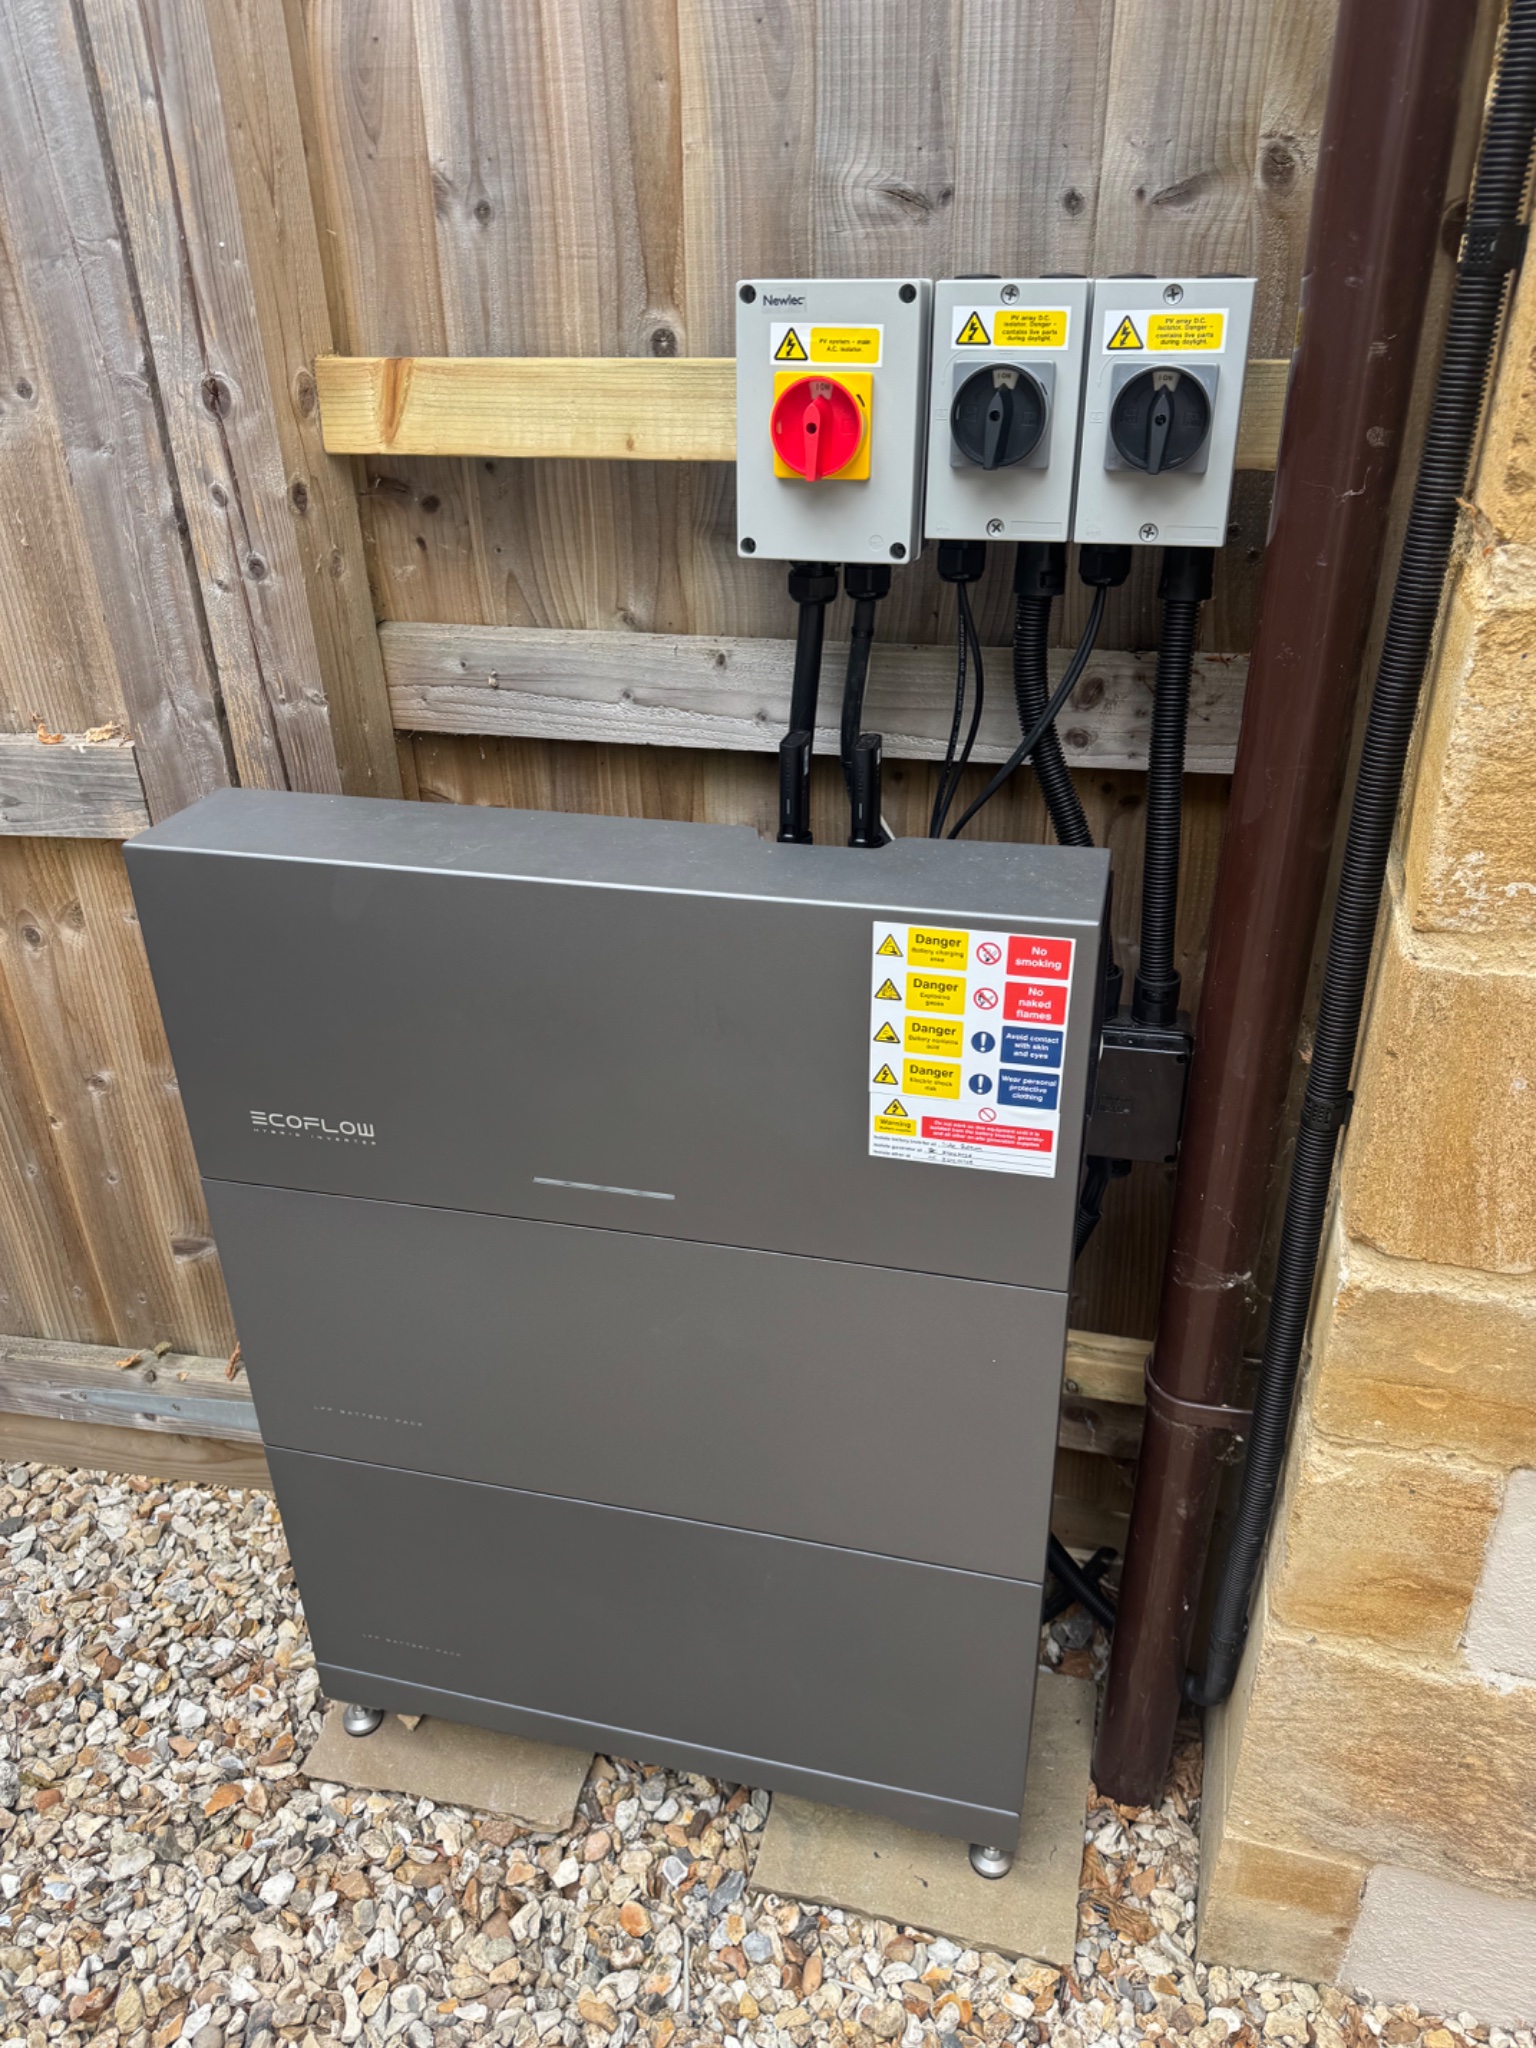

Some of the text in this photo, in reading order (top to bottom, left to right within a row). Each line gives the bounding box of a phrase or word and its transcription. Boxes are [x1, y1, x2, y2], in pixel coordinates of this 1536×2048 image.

[763, 294, 805, 306] Newlec
[915, 934, 962, 948] Danger
[912, 946, 964, 958] Battery charging
[1031, 946, 1048, 956] No
[1015, 958, 1062, 971] smoking
[913, 978, 958, 993] Danger
[1028, 987, 1044, 997] No
[1018, 998, 1051, 1009] naked
[1016, 1009, 1052, 1021] flames
[912, 1022, 956, 1036] Danger
[908, 1034, 930, 1043] Battery
[1006, 1032, 1059, 1044] Avoid contact
[910, 1064, 954, 1078] Danger
[910, 1076, 952, 1087] Electric shock
[1002, 1075, 1057, 1087] Wear personal
[1008, 1085, 1048, 1094] protective
[1012, 1092, 1043, 1102] clothing
[250, 1110, 375, 1138] ECOFLOW
[880, 1118, 912, 1128] Warning
[253, 1128, 376, 1146] HYBRID INVERTER
